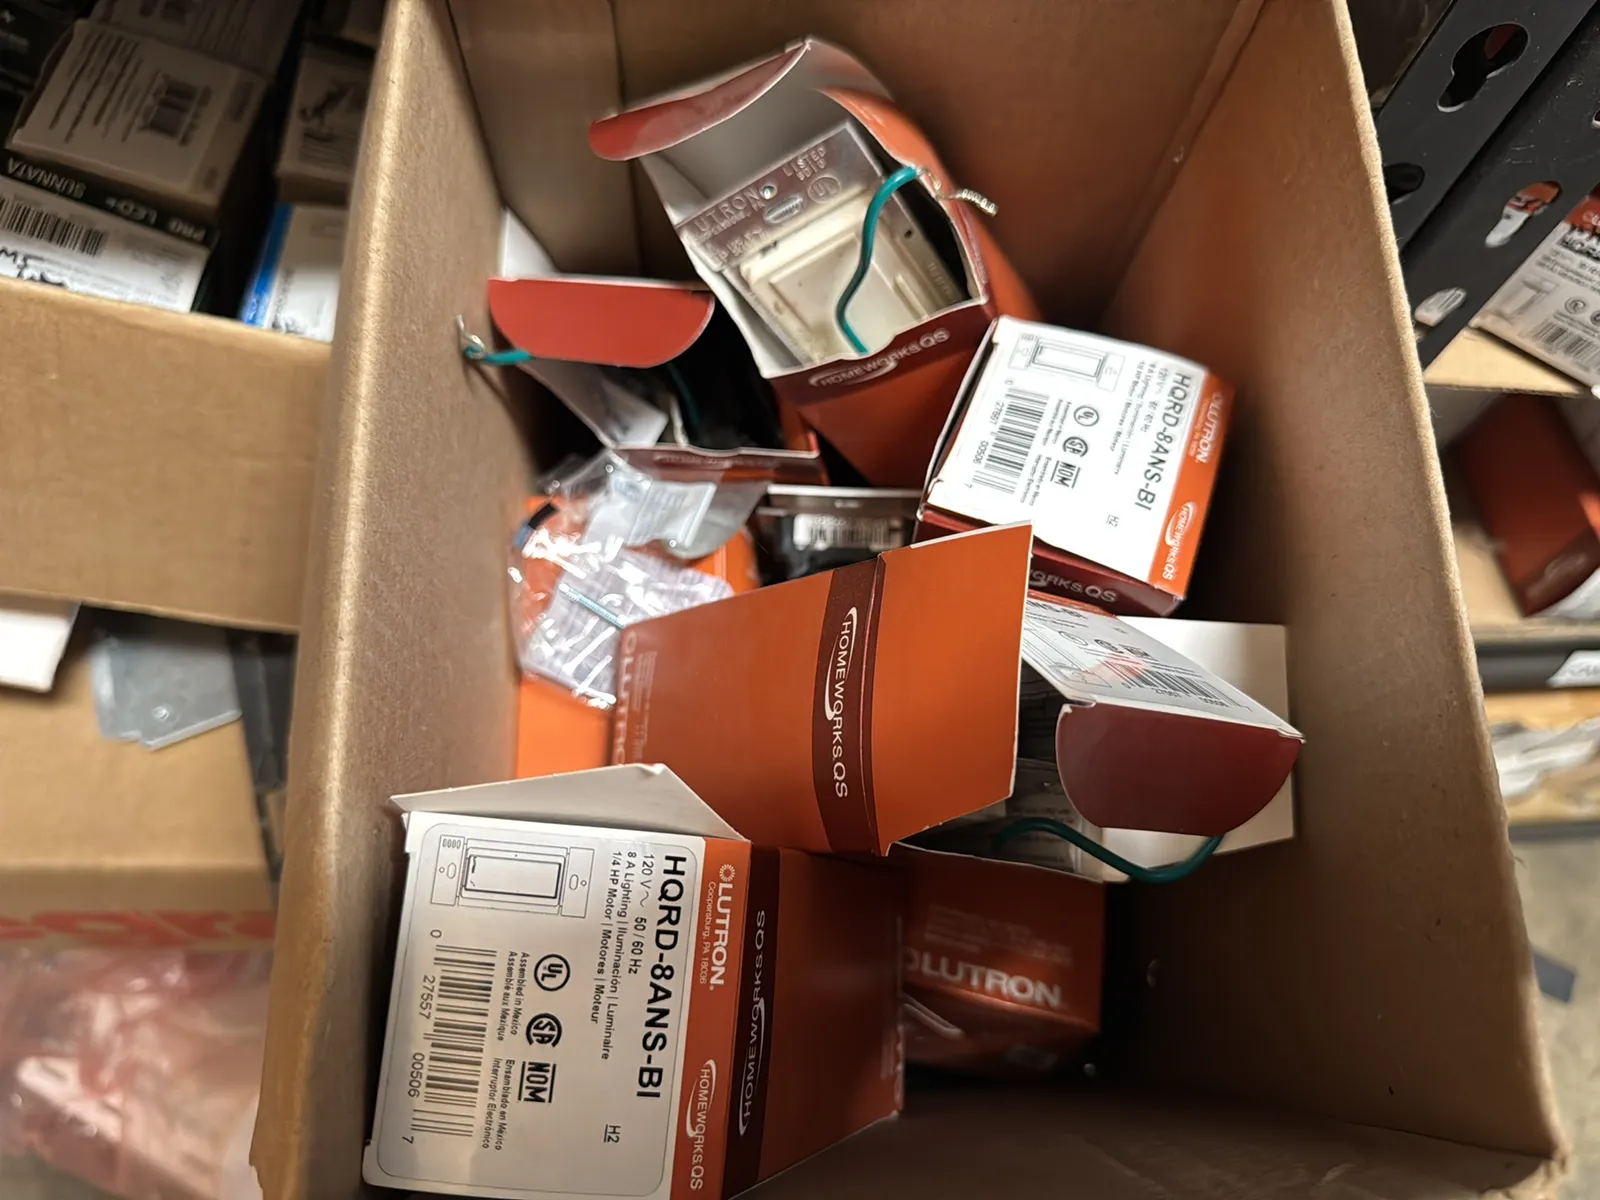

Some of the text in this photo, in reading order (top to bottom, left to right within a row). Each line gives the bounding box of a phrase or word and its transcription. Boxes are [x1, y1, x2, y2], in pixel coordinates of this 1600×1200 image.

[6, 157, 88, 200] SUNNATA
[782, 147, 827, 177] LISTED
[694, 187, 761, 233] UTRON
[814, 327, 950, 389] HOMEWORKS QS
[1134, 372, 1192, 512] HQRD-8ANS-BI
[1195, 401, 1222, 464] LUTRON
[1054, 461, 1078, 488] NOM
[1161, 502, 1193, 581] HOMEWORKS QS
[1085, 585, 1117, 602] QS
[827, 612, 855, 798] HOMEWORKS QS
[608, 868, 621, 885] HP
[611, 851, 622, 867] 1/4
[625, 860, 636, 869] A
[627, 851, 637, 859] 8
[641, 854, 656, 876] 120
[604, 887, 618, 920] Motor
[617, 872, 635, 918] Lighting
[634, 916, 648, 932] 50
[699, 881, 717, 984] Coopersburg, PA 18036
[709, 883, 734, 986] LUTRON
[597, 928, 613, 976] Motores
[610, 925, 629, 994] Iluminación
[627, 958, 643, 975] Hz
[631, 940, 645, 956] 60
[501, 991, 510, 1006] aux
[510, 951, 530, 1036] Assembled in Mexico
[636, 855, 688, 1098] HQRD-8ANS-BI
[920, 951, 1062, 1010] LUTRON
[497, 1007, 511, 1041] Mexique
[590, 983, 606, 1024] Moteur
[740, 909, 766, 1125] HOMEWORKS QS
[402, 929, 442, 1145] 0 27557 00506 7
[601, 1002, 619, 1060] Luminaire
[482, 1057, 502, 1149] Interruptor Electrónico
[500, 1058, 516, 1109] Ensamblado
[523, 1061, 551, 1103] NOM
[499, 1110, 507, 1121] en
[605, 1124, 622, 1144] H2
[687, 1061, 715, 1192] HOMEWORKS QS
